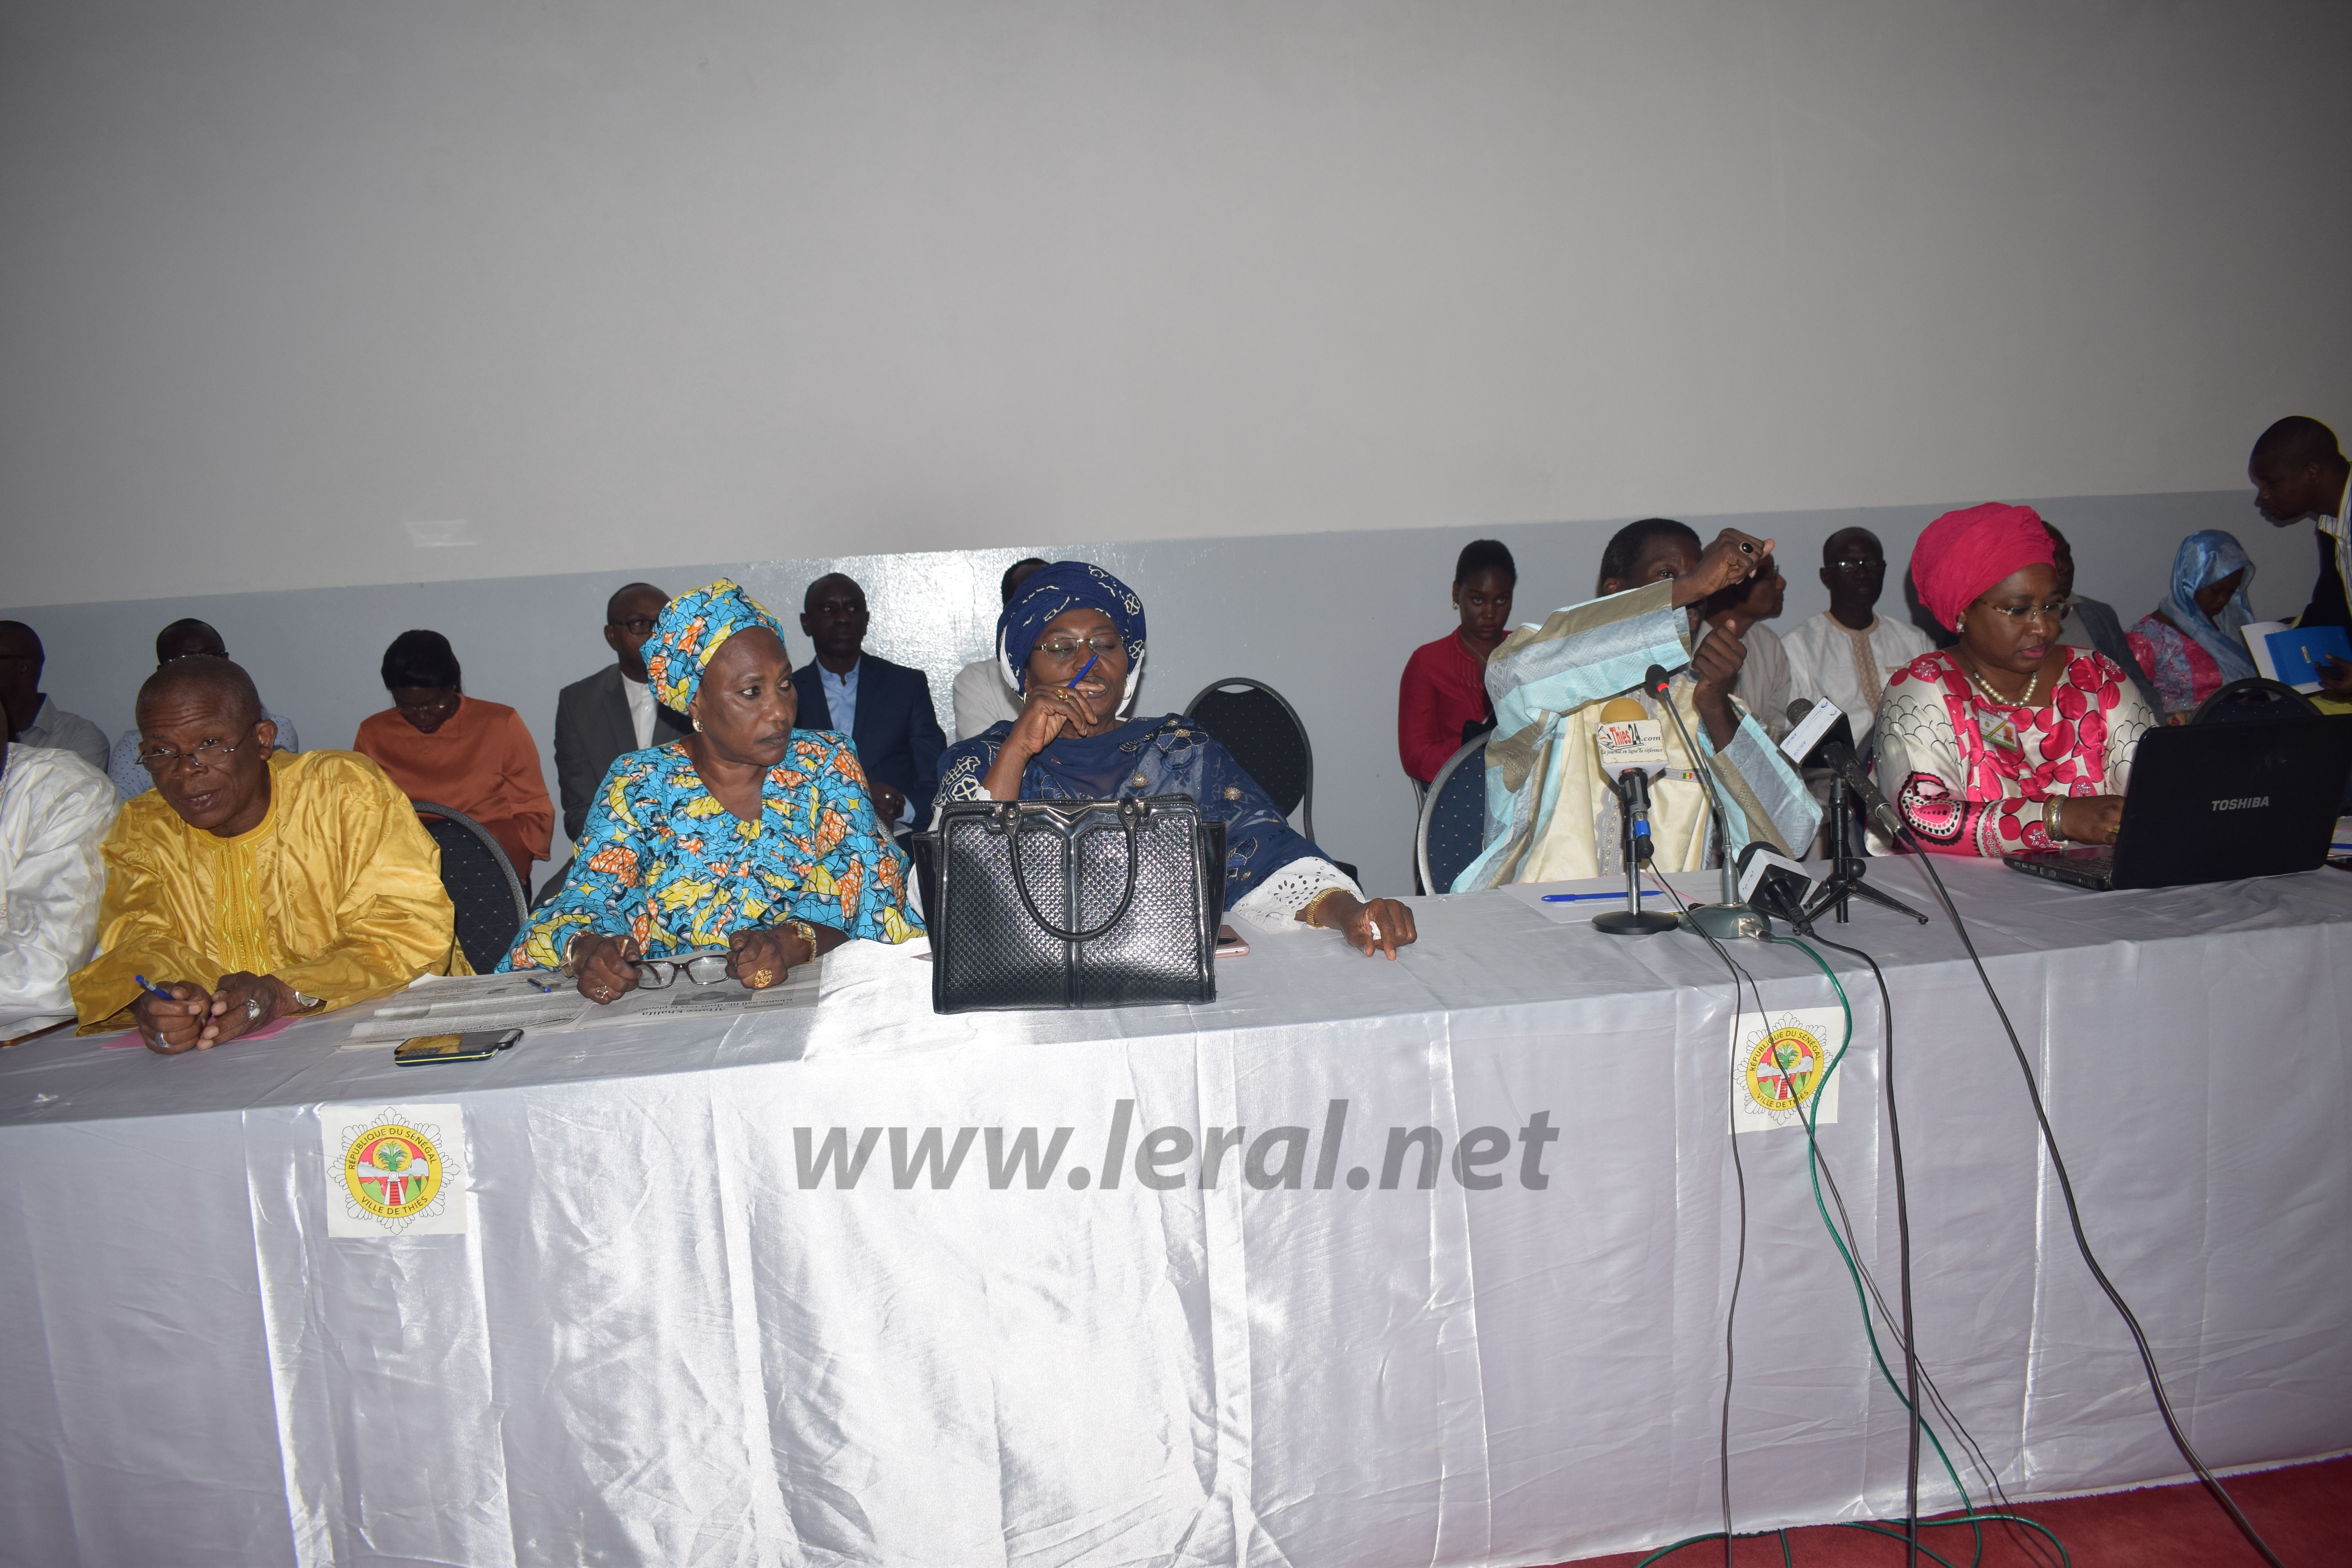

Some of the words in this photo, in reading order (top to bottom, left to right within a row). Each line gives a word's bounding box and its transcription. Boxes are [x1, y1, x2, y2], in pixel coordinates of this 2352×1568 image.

[2212, 796, 2269, 811] TOSHIBA
[1798, 1033, 1821, 1061] SÉNÉGAL
[1757, 1093, 1774, 1108] VILLE
[348, 1129, 387, 1170] RÉPUBLIQUE
[405, 1130, 437, 1165] SÉNÉGAL
[361, 1196, 383, 1214] VILLE
[403, 1196, 428, 1213] THIÈS
